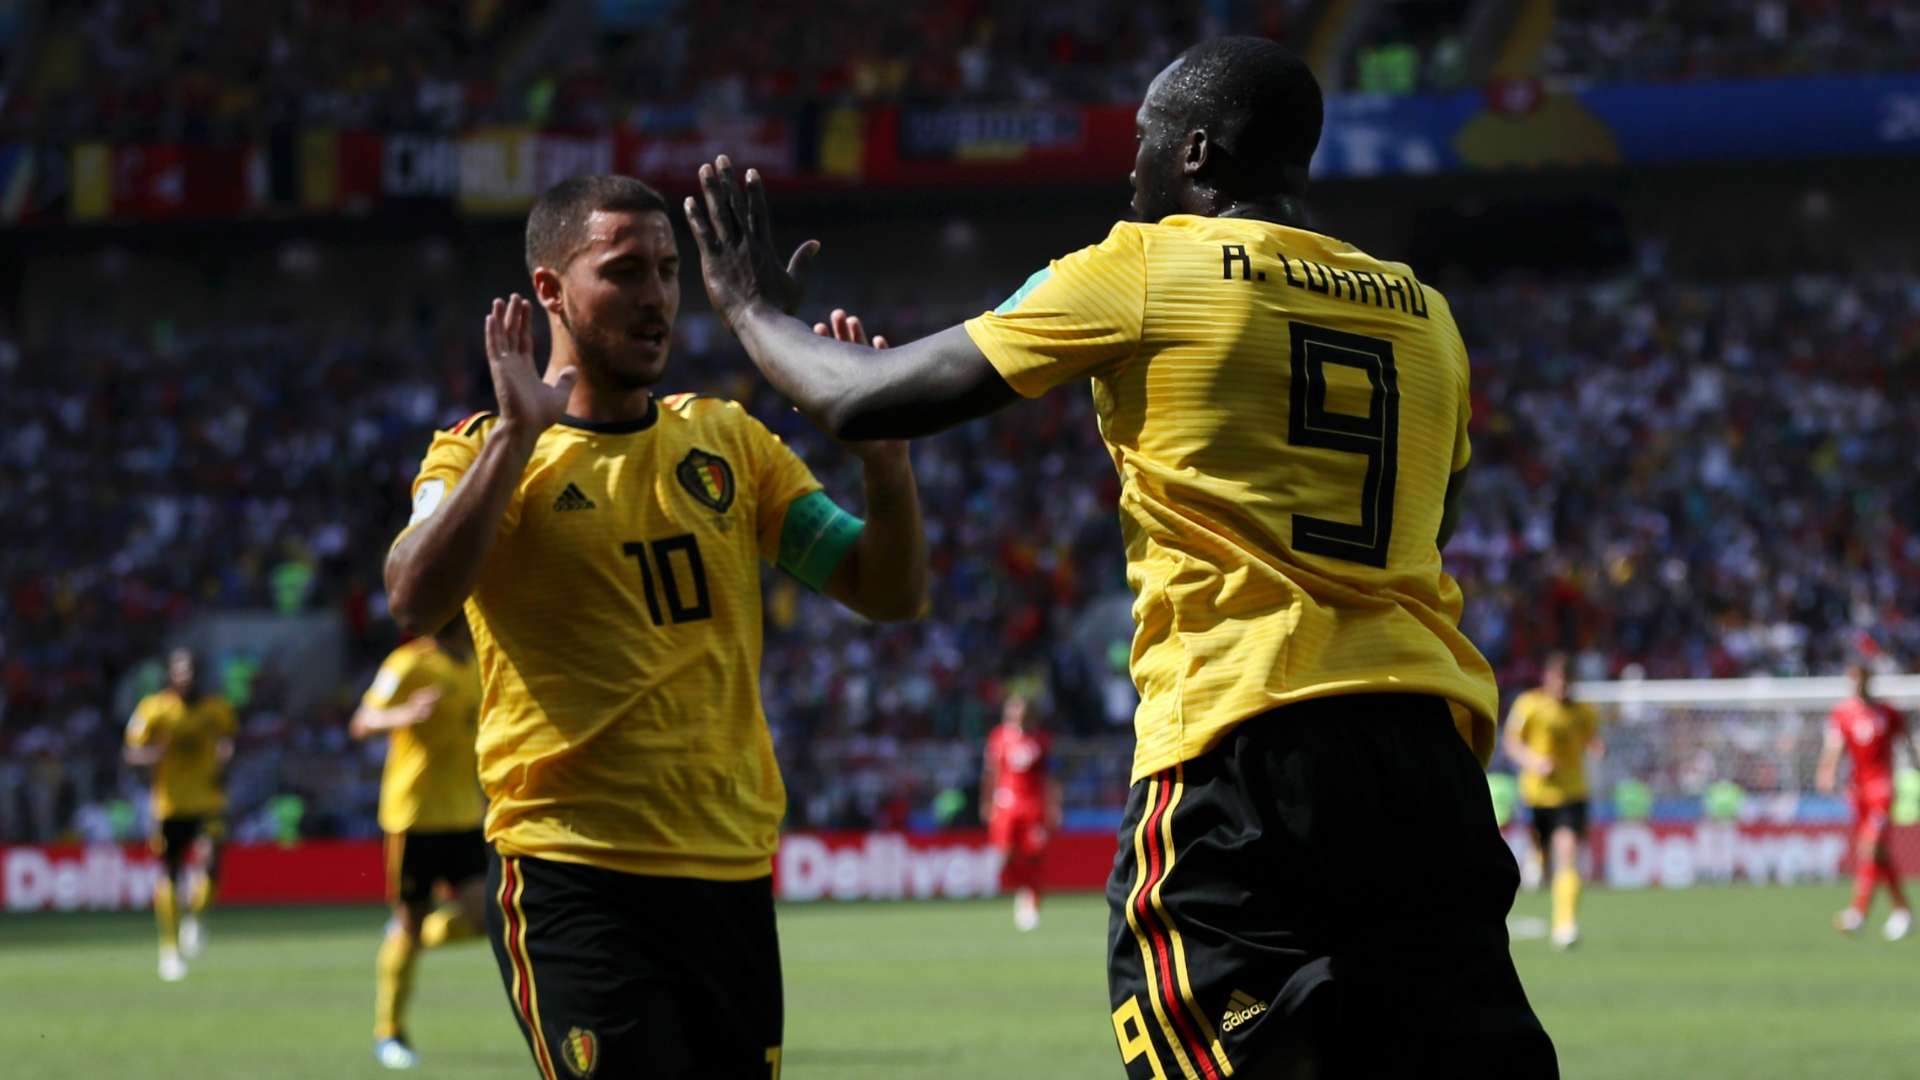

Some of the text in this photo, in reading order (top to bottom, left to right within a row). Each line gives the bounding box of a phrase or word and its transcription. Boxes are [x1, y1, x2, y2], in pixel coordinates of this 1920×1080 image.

[1222, 244, 1429, 320] R. LUKAKU
[1288, 320, 1400, 570] 9
[623, 532, 713, 627] 10
